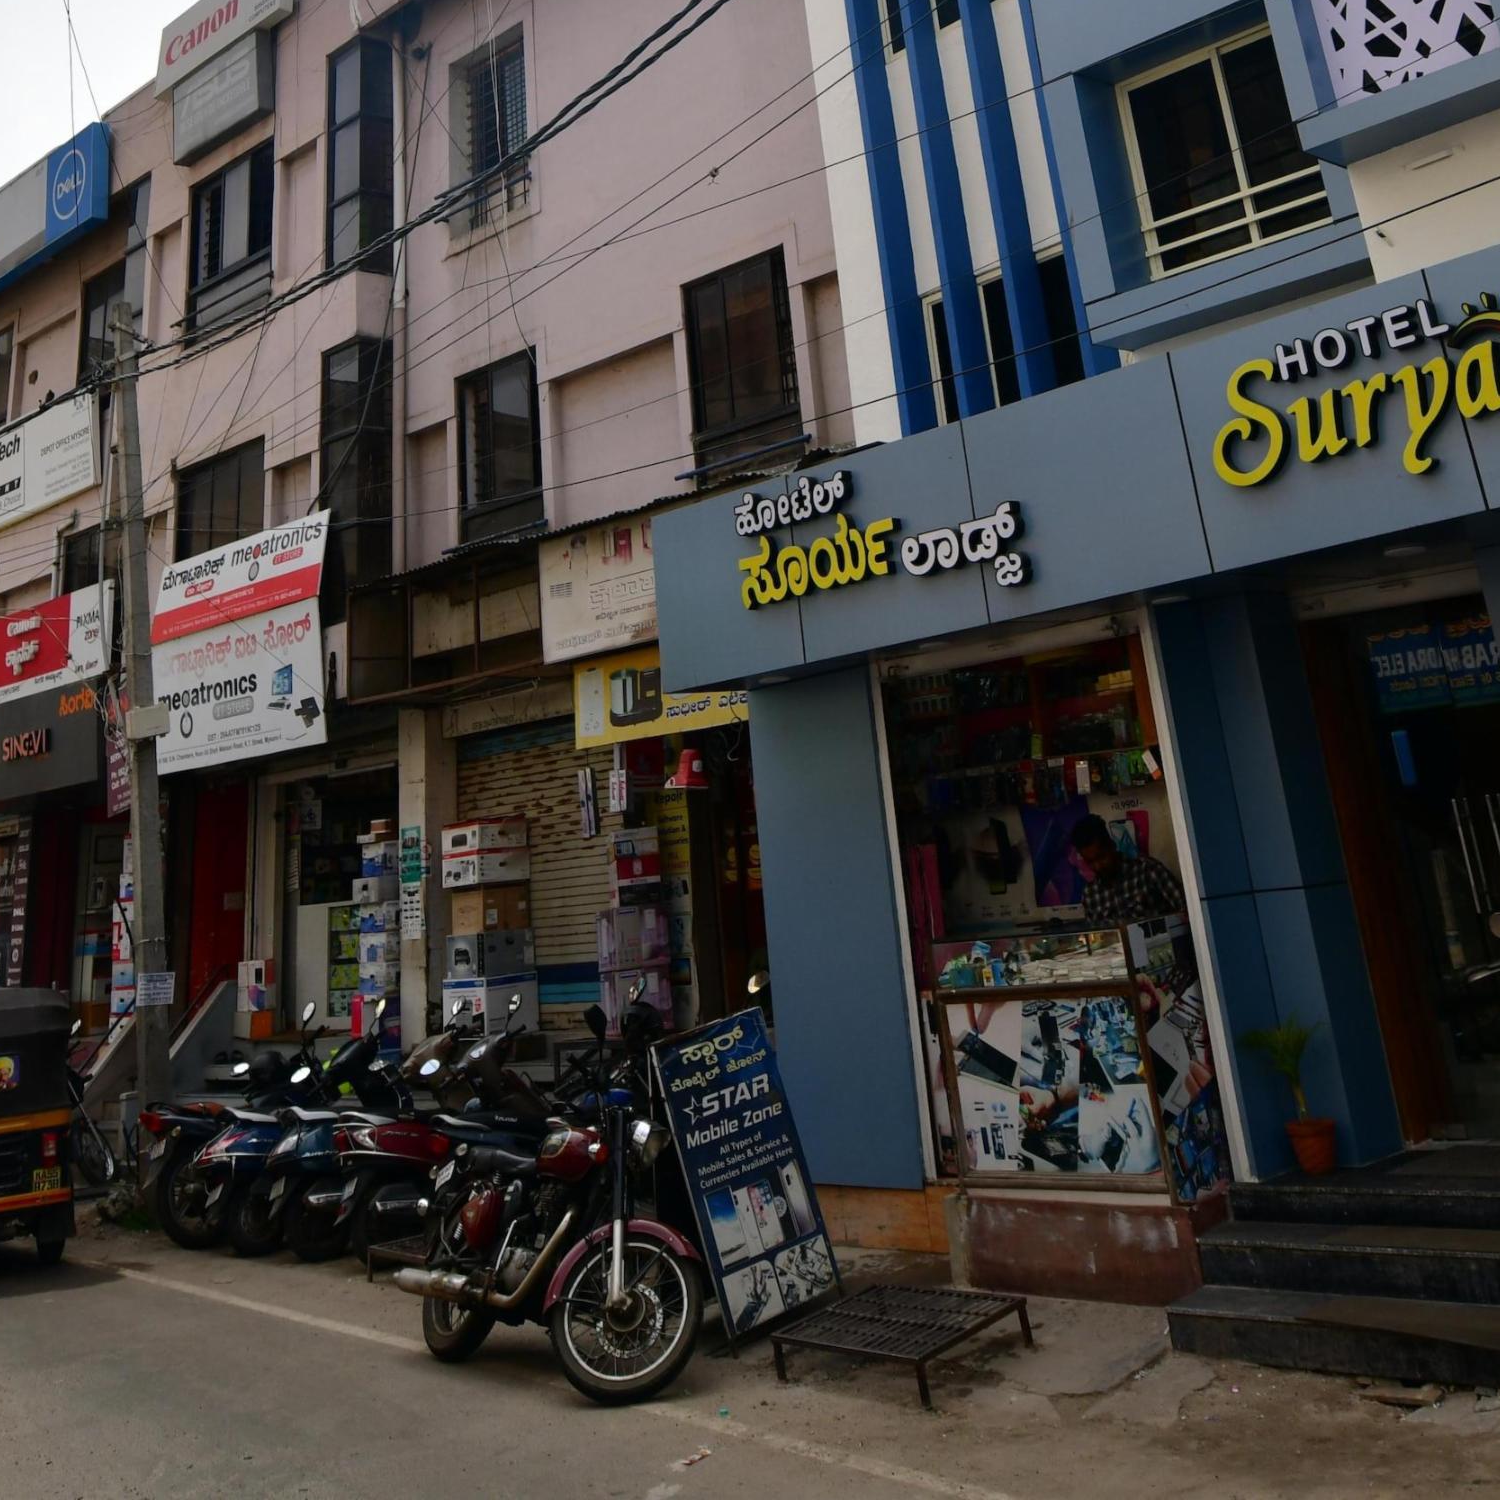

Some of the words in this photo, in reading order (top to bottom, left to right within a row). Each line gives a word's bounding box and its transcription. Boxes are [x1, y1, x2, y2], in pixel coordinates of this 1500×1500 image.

[57, 170, 83, 200] DELL
[1275, 299, 1450, 381] HOTEL
[734, 471, 846, 536] ಹೋಟೆಲ್
[679, 1026, 744, 1067] ಸ್ಟಾರ್
[701, 1073, 770, 1117] STAR
[686, 1118, 739, 1149] Mobile
[743, 1102, 783, 1128] Zone
[719, 1142, 730, 1155] All
[731, 1135, 753, 1153] Types
[753, 1131, 762, 1144] of
[697, 1159, 725, 1177] Mobile
[726, 1153, 745, 1169] Sales
[754, 1138, 781, 1157] Service
[741, 1154, 774, 1176] Available
[775, 1146, 794, 1161] Here
